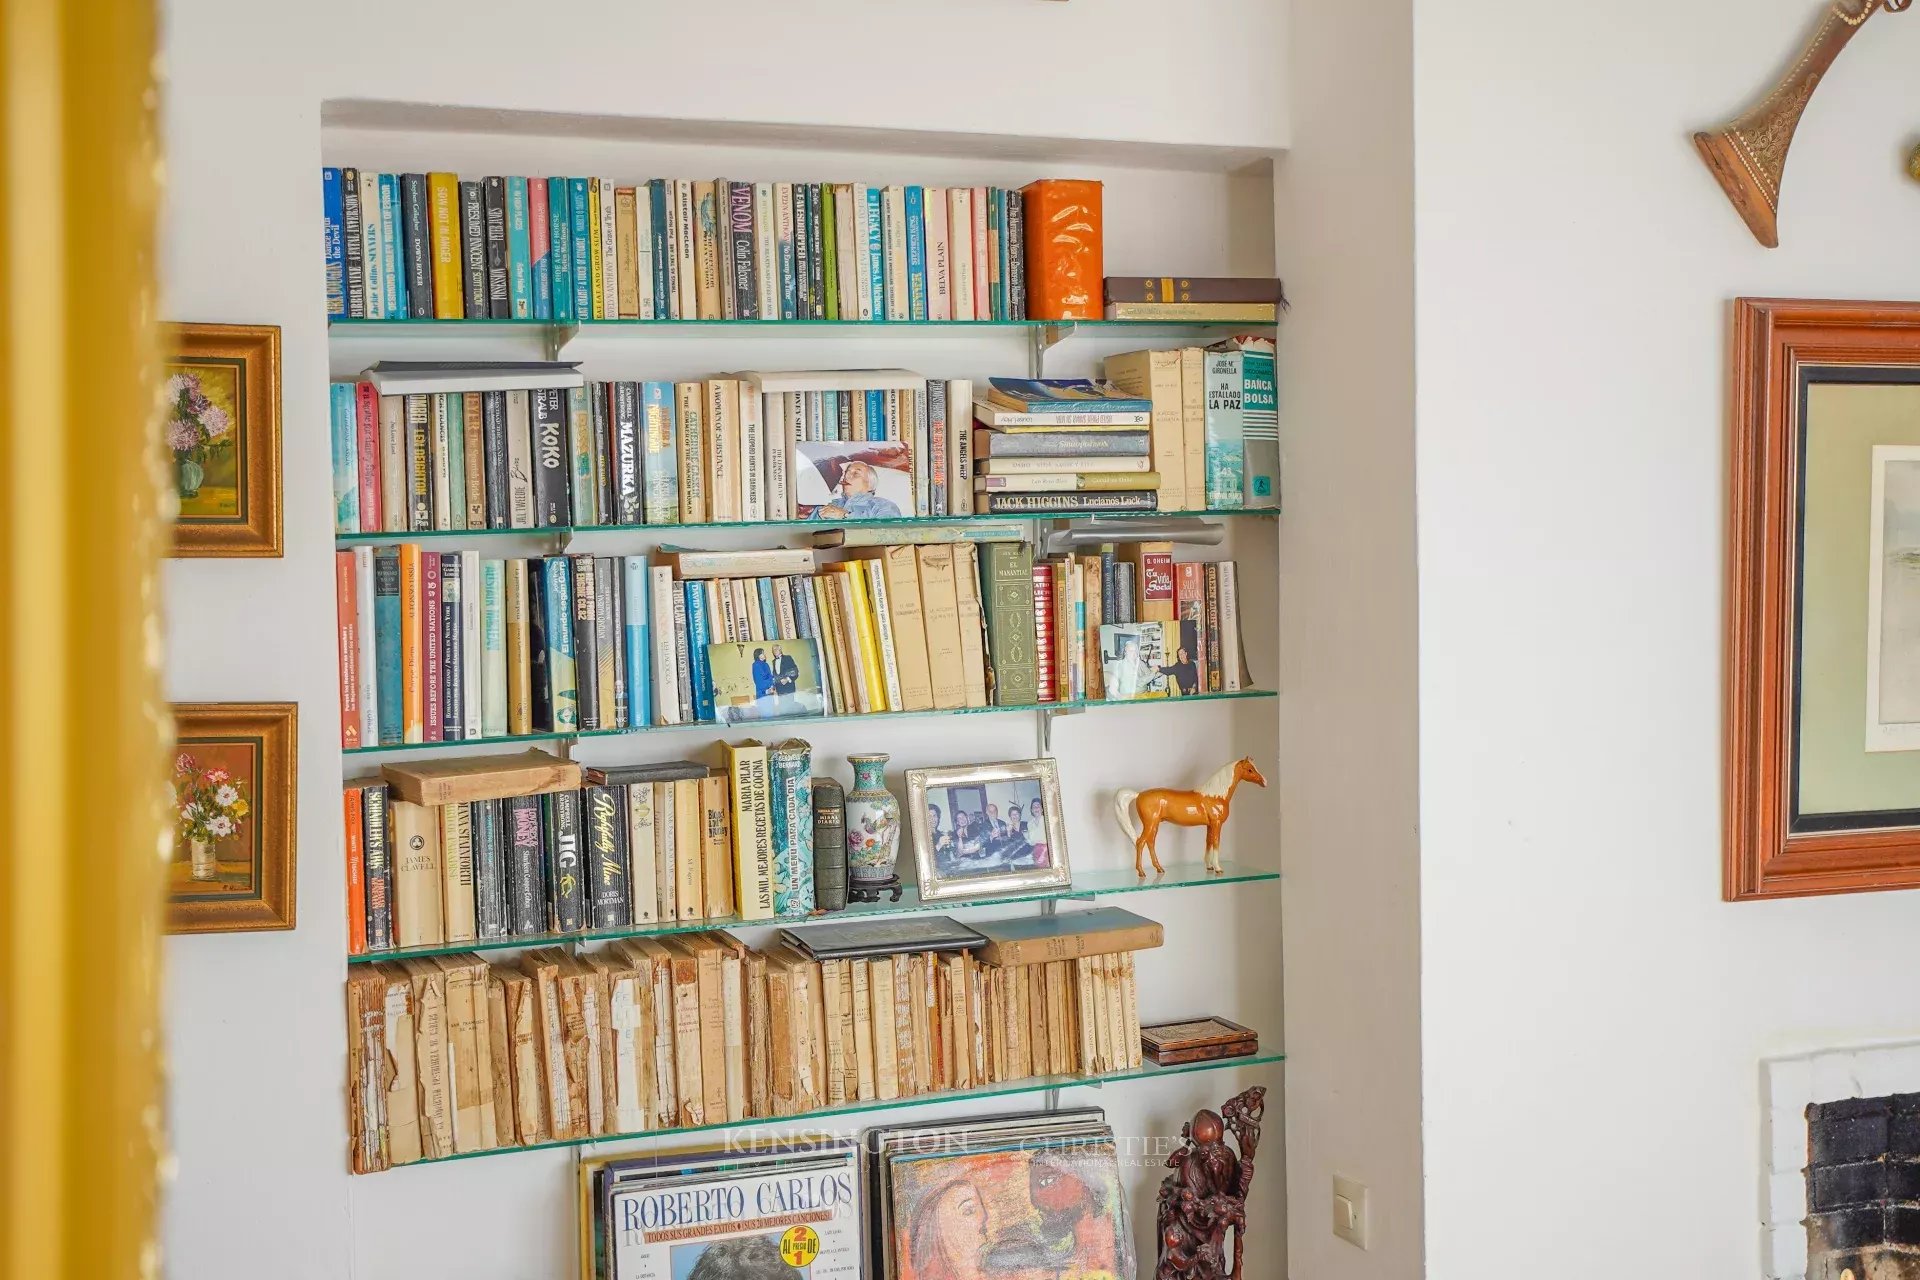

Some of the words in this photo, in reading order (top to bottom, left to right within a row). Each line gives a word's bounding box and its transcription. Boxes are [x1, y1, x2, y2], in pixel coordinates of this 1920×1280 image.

[439, 207, 449, 223] NOT
[468, 202, 480, 236] PRESUMED
[731, 187, 753, 233] VENOM
[868, 202, 881, 240] LEGACY
[1010, 207, 1018, 217] The
[332, 224, 340, 244] Devil
[368, 224, 376, 262] SINNERS
[440, 235, 451, 262] ANGER
[469, 238, 482, 270] INNOCENT
[737, 240, 750, 259] Colin
[784, 246, 790, 254] No
[783, 254, 792, 274] Enemy
[869, 253, 880, 273] James
[369, 265, 378, 289] Collins
[473, 272, 482, 287] SCOTT
[738, 261, 753, 290] Falconer
[938, 269, 946, 295] BELVA
[371, 292, 379, 316] Jackie
[1209, 391, 1241, 399] ESTALLADO
[1245, 379, 1272, 391] BANCA
[1209, 400, 1220, 409] LA
[1224, 400, 1241, 409] PAZ
[1245, 393, 1273, 404] BOLSA
[414, 429, 425, 446] LEN
[540, 423, 560, 468] KOKO
[471, 450, 479, 479] Spanish
[620, 422, 634, 495] MAZURKA
[415, 449, 426, 495] DEIGHTON
[692, 465, 700, 498] GASKIN
[472, 480, 480, 500] Bride
[515, 487, 526, 511] TWEEDIE
[1084, 496, 1119, 506] Luciano's
[1121, 496, 1141, 505] Luck
[995, 498, 1025, 509] JACK
[1027, 496, 1079, 508] HIGGINS
[578, 573, 586, 597] ENGINE
[1146, 581, 1172, 595] Social
[1209, 567, 1217, 598] GREEN
[673, 588, 683, 604] THE
[691, 585, 699, 608] DAVID
[779, 590, 788, 604] Gay
[587, 601, 595, 620] FROM
[674, 605, 685, 625] CLAW
[693, 610, 702, 633] NIVEN
[1209, 600, 1218, 630] LIGHT
[563, 644, 569, 653] El
[740, 760, 751, 784] PILAR
[753, 759, 764, 789] COCINA
[742, 786, 752, 811] MARIA
[754, 791, 764, 800] DE
[369, 792, 382, 848] SCHINDLER'S
[514, 808, 529, 847] MONEY
[593, 793, 616, 853] Rightfully
[755, 802, 766, 837] RECETAS
[369, 850, 385, 869] ARK
[458, 829, 471, 886] STAINFORTH
[558, 831, 576, 868] JIG
[757, 838, 768, 876] MEJORES
[601, 854, 621, 885] Mine
[759, 878, 769, 892] MIL
[791, 877, 798, 890] UN
[759, 894, 770, 909] LAS
[623, 1185, 744, 1231] ROBERTO
[756, 1172, 852, 1214] CARLOS
[765, 1216, 792, 1228] MEJORES
[647, 1230, 669, 1243] TODOS
[670, 1228, 682, 1241] SUS
[682, 1226, 712, 1238] GRANDES
[783, 1239, 791, 1254] AL
[793, 1242, 806, 1250] PRECIO
[807, 1238, 816, 1254] DE
[794, 1227, 806, 1242] 2
[794, 1251, 802, 1265] 1
